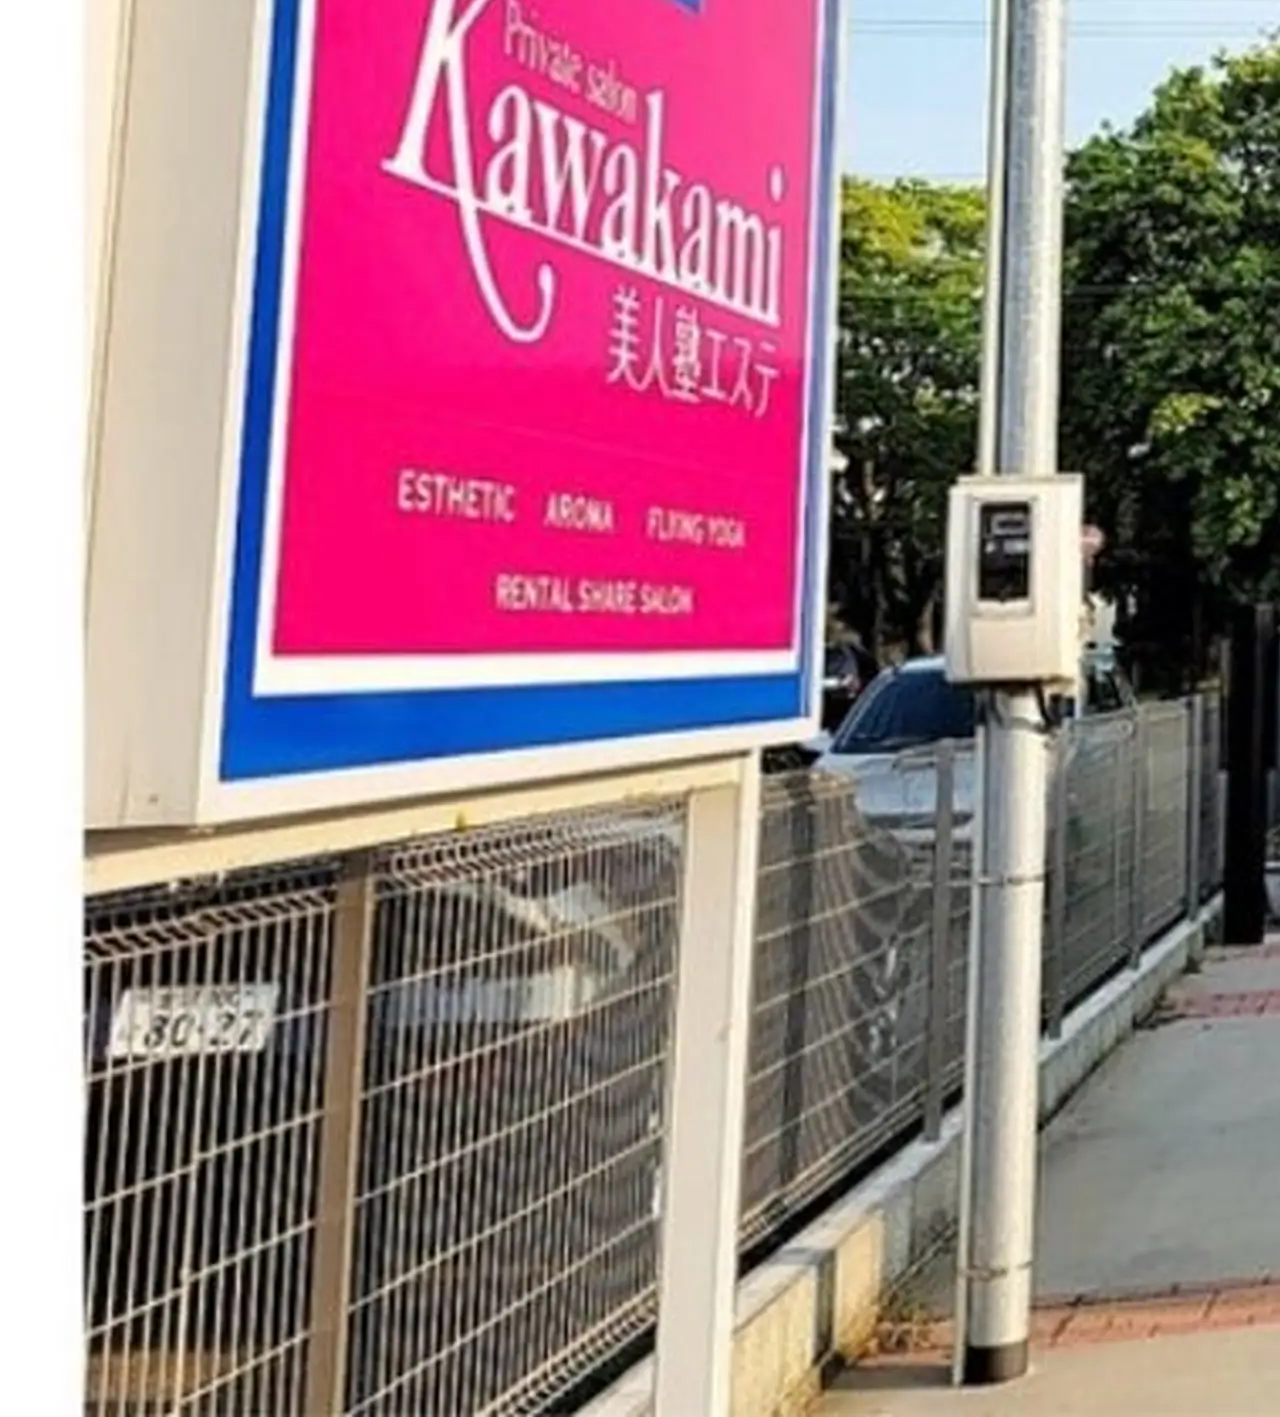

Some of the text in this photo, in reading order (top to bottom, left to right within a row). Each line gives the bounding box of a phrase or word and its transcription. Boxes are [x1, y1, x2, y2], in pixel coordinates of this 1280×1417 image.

[584, 59, 637, 124] salon
[607, 284, 780, 418] 美人塾エステ
[398, 469, 516, 523] ESTHETIC
[544, 491, 616, 533] AROMA
[496, 573, 694, 615] RENTAL SHARE SALON
